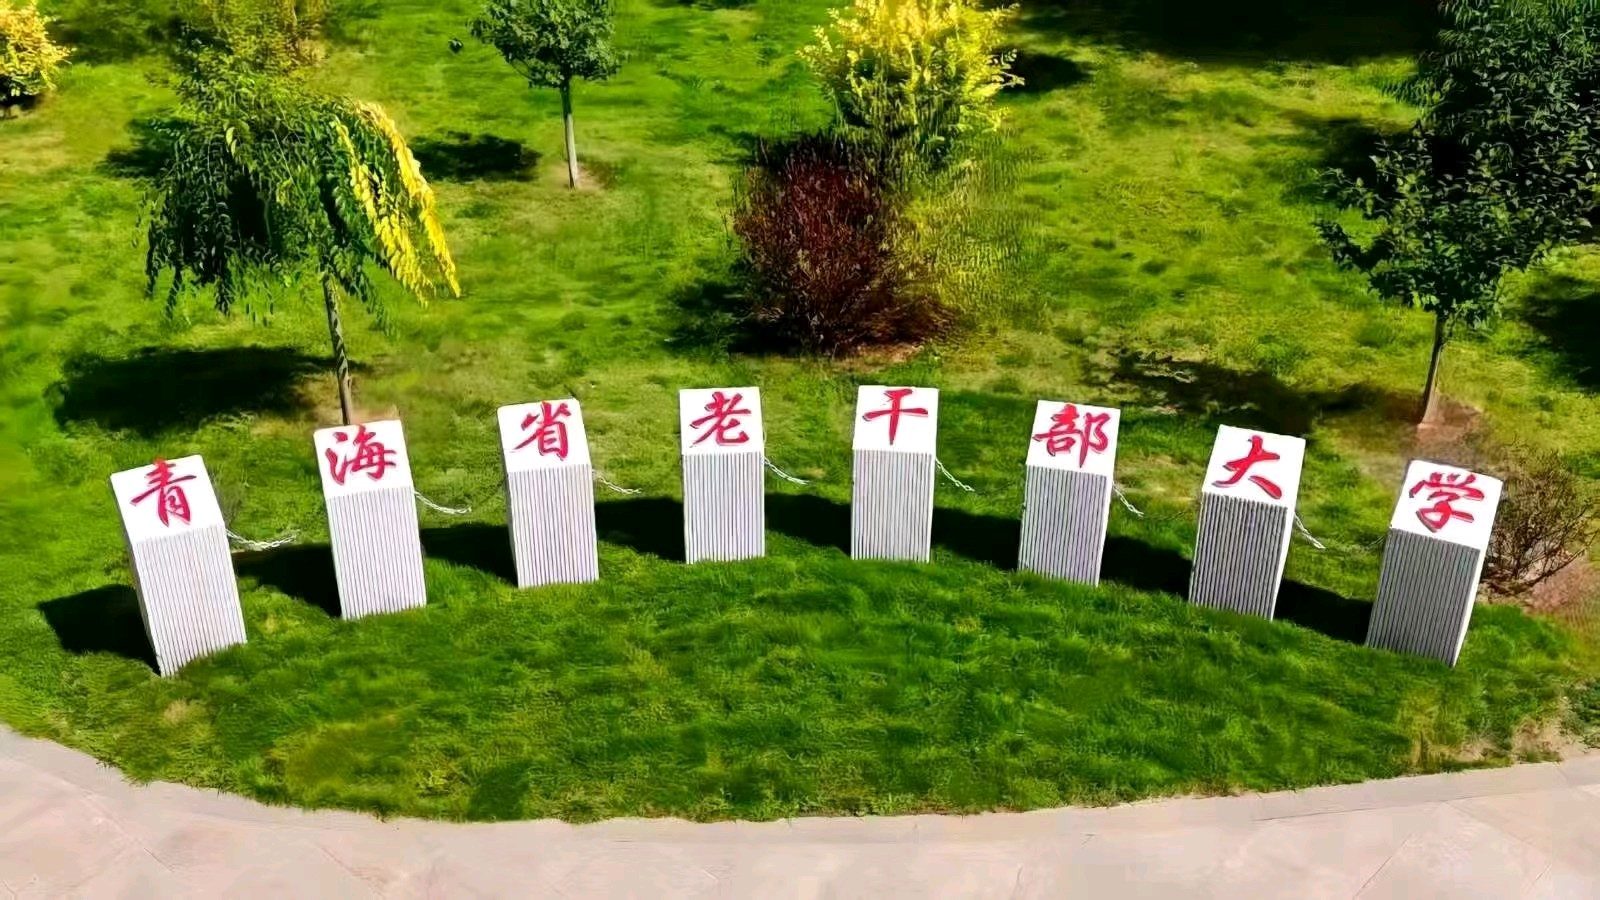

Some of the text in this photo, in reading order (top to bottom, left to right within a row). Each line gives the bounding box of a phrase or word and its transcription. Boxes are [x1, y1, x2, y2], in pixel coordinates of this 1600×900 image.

[131, 388, 1485, 533] 青 海 省 老 干 部 大 学
